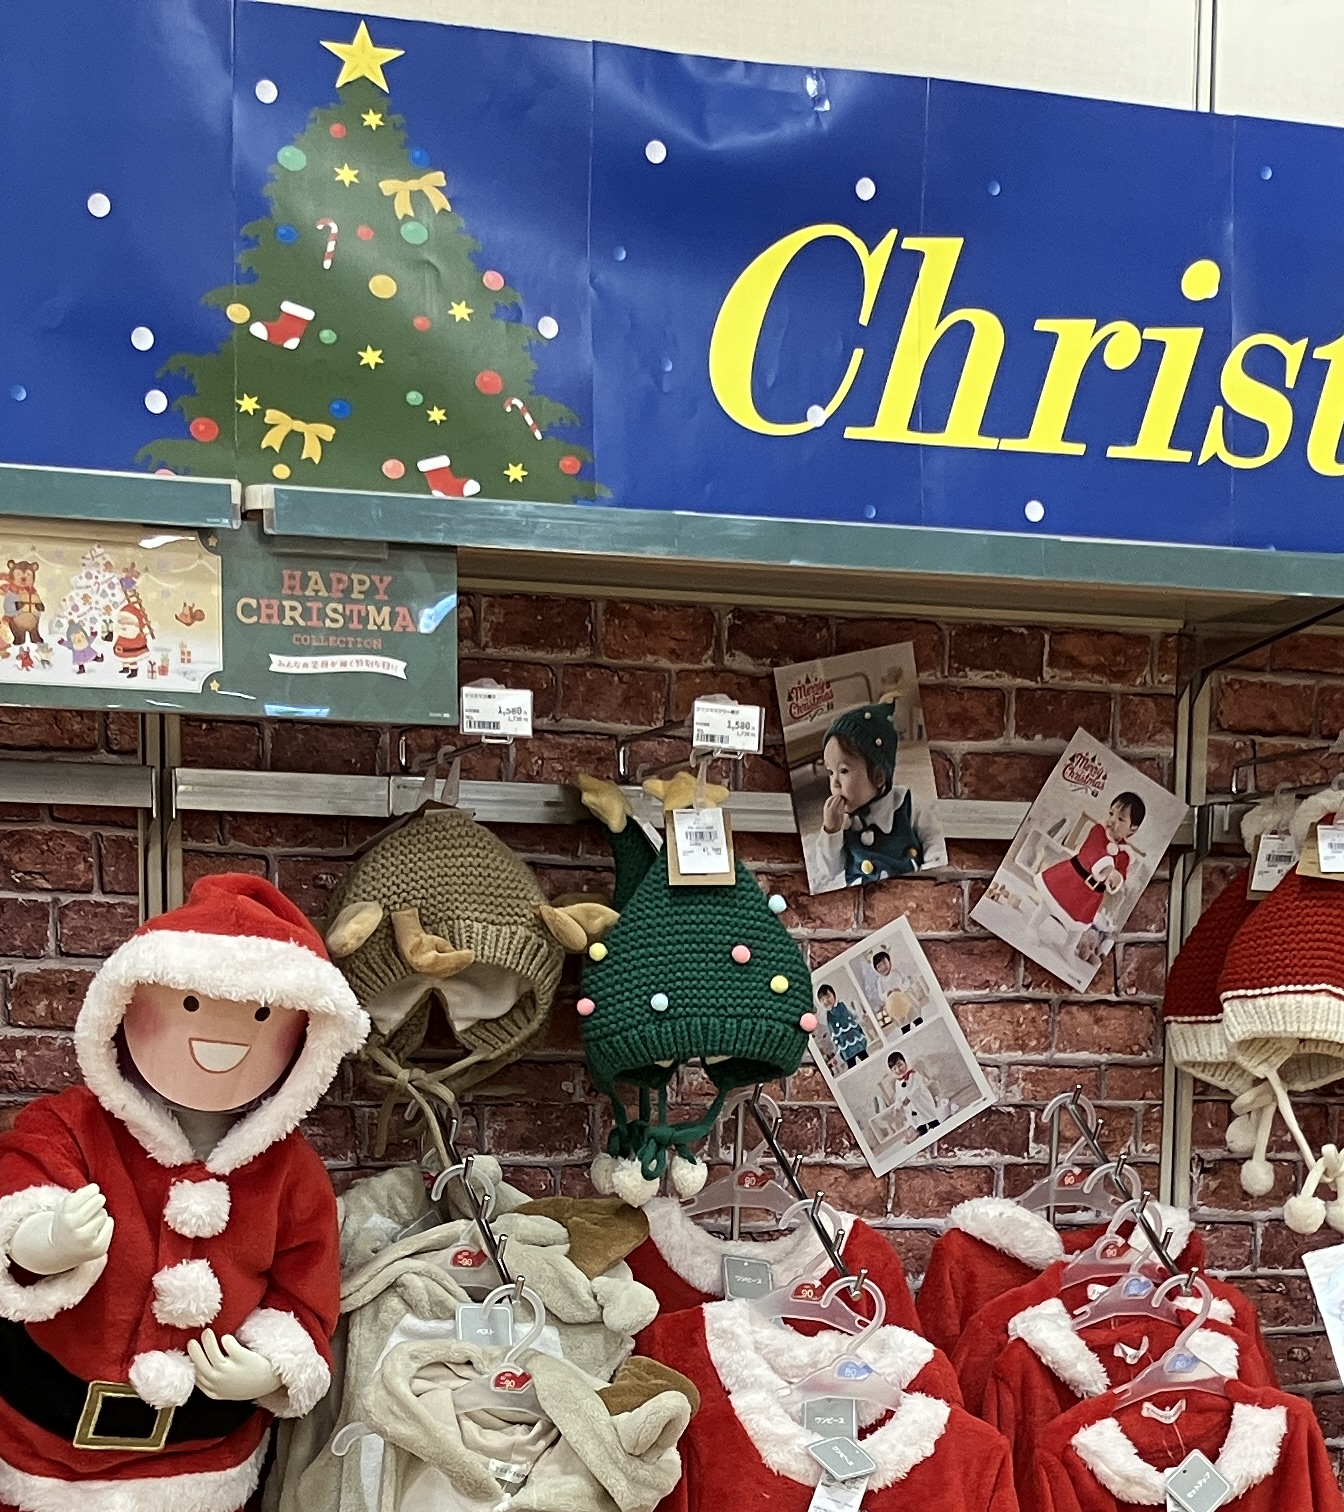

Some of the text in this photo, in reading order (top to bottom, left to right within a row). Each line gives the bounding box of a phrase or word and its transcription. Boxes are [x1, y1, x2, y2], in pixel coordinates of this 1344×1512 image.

[282, 569, 392, 600] HAPPY
[236, 596, 422, 634] CHRISTMA
[293, 633, 383, 650] COLLECTION
[814, 1416, 845, 1425] ワンピース
